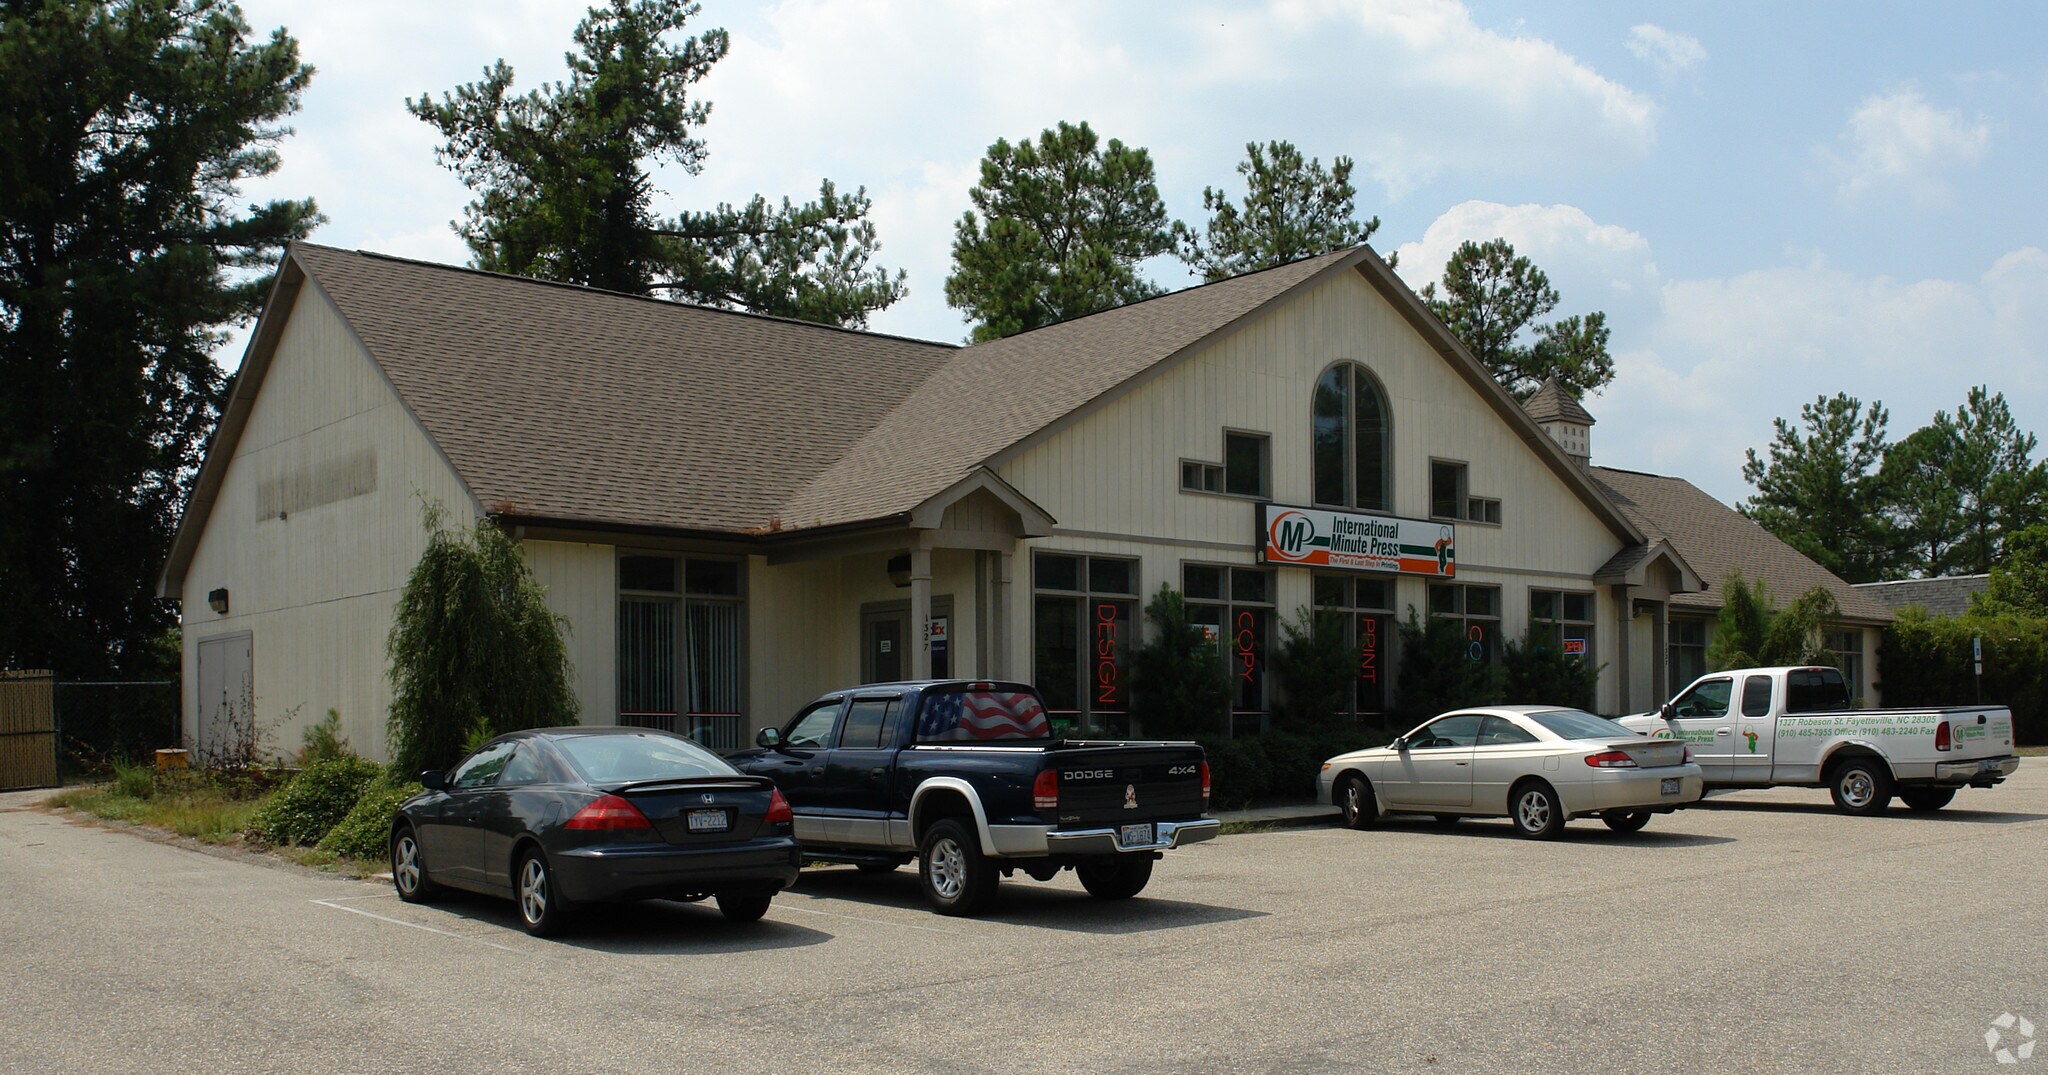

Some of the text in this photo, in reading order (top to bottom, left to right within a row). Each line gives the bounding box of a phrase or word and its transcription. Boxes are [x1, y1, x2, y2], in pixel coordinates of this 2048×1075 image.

[1333, 515, 1399, 539] International
[1330, 533, 1399, 557] Minute Press
[1329, 556, 1338, 564] The
[1098, 604, 1117, 702] DESIGN
[1238, 611, 1255, 682] COPY
[1361, 618, 1376, 684] PRINT
[1778, 726, 1936, 739] (910) 485-7955 Office (910) 483-2240 Fax
[1779, 718, 1796, 727] 1327
[1798, 718, 1832, 726] Robeson
[1846, 716, 1894, 727] Fayetteville,
[1896, 716, 1909, 724] NC
[1912, 715, 1937, 724] 28305
[1064, 769, 1113, 780] DODGE
